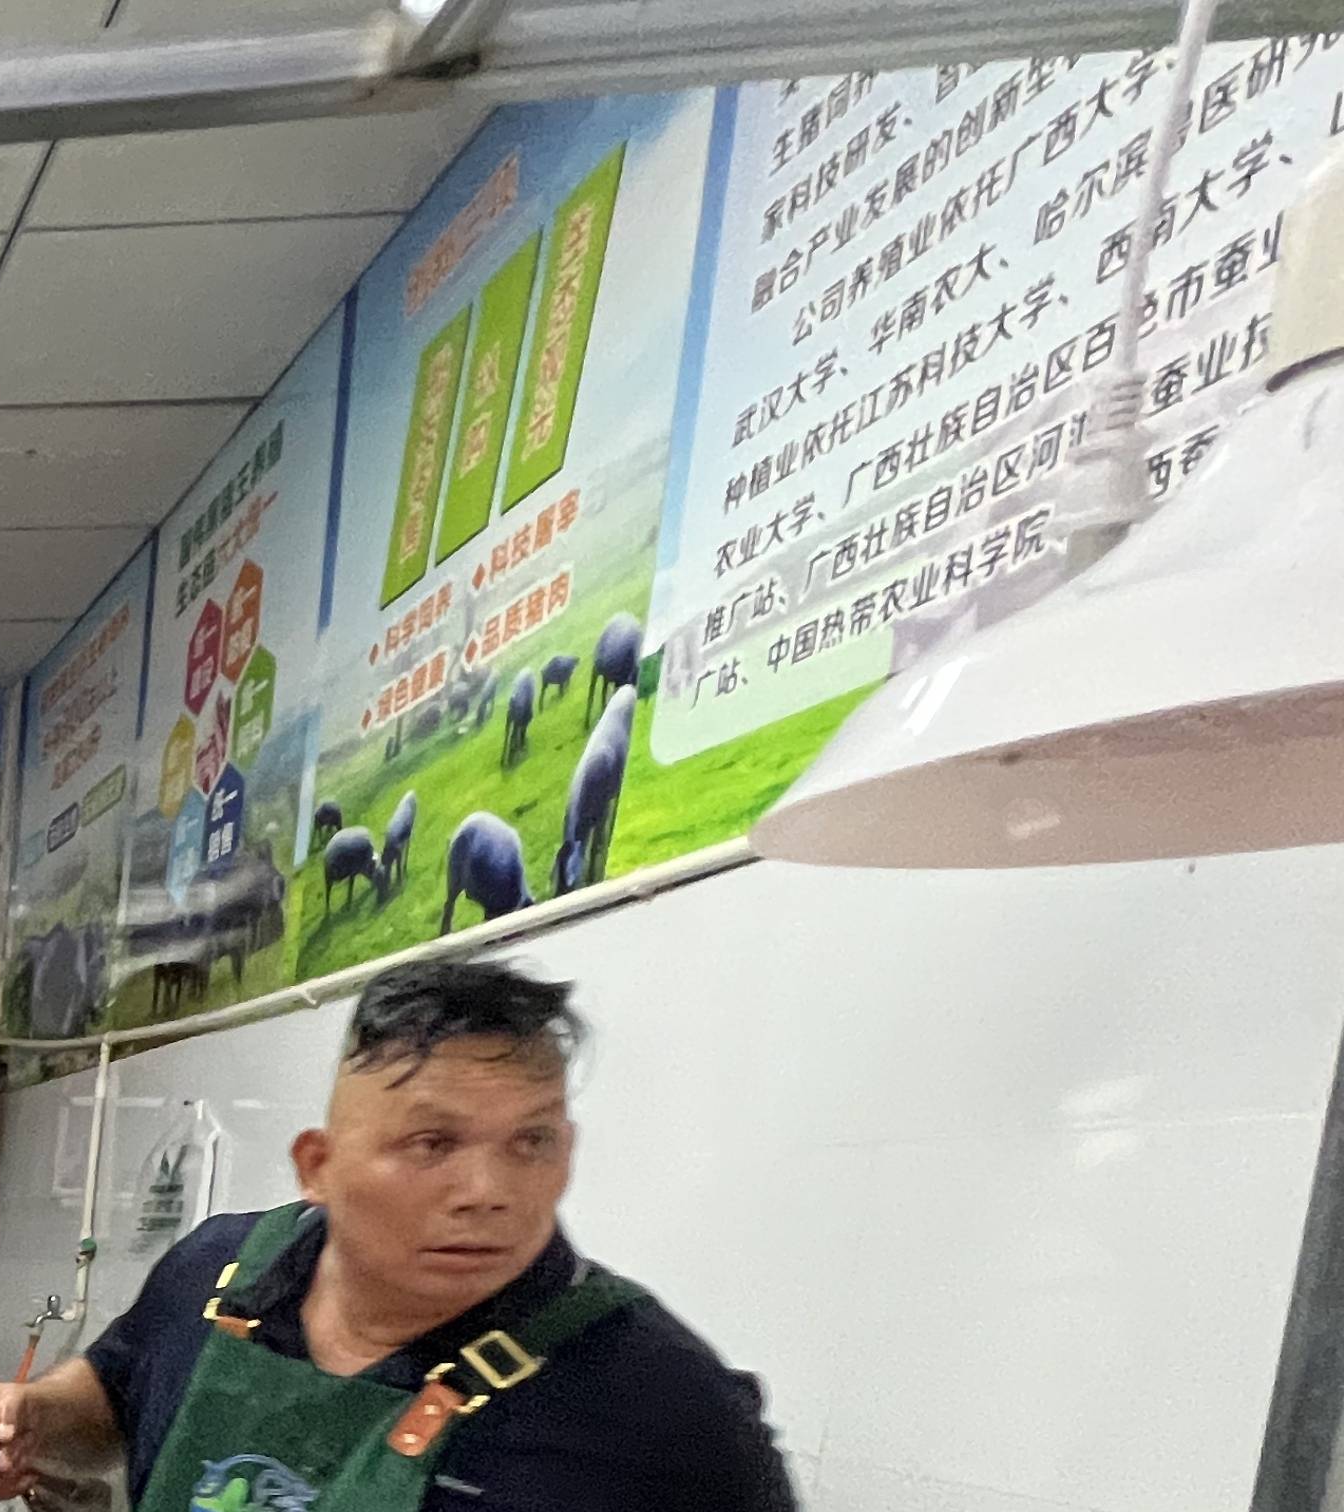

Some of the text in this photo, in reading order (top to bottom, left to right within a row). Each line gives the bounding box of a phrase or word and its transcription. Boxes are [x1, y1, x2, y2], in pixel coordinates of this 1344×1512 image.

[752, 56, 1077, 313] 融合产业发展的创新型
[703, 313, 1273, 646] 推广站、广西壮族自治区河蚕业
